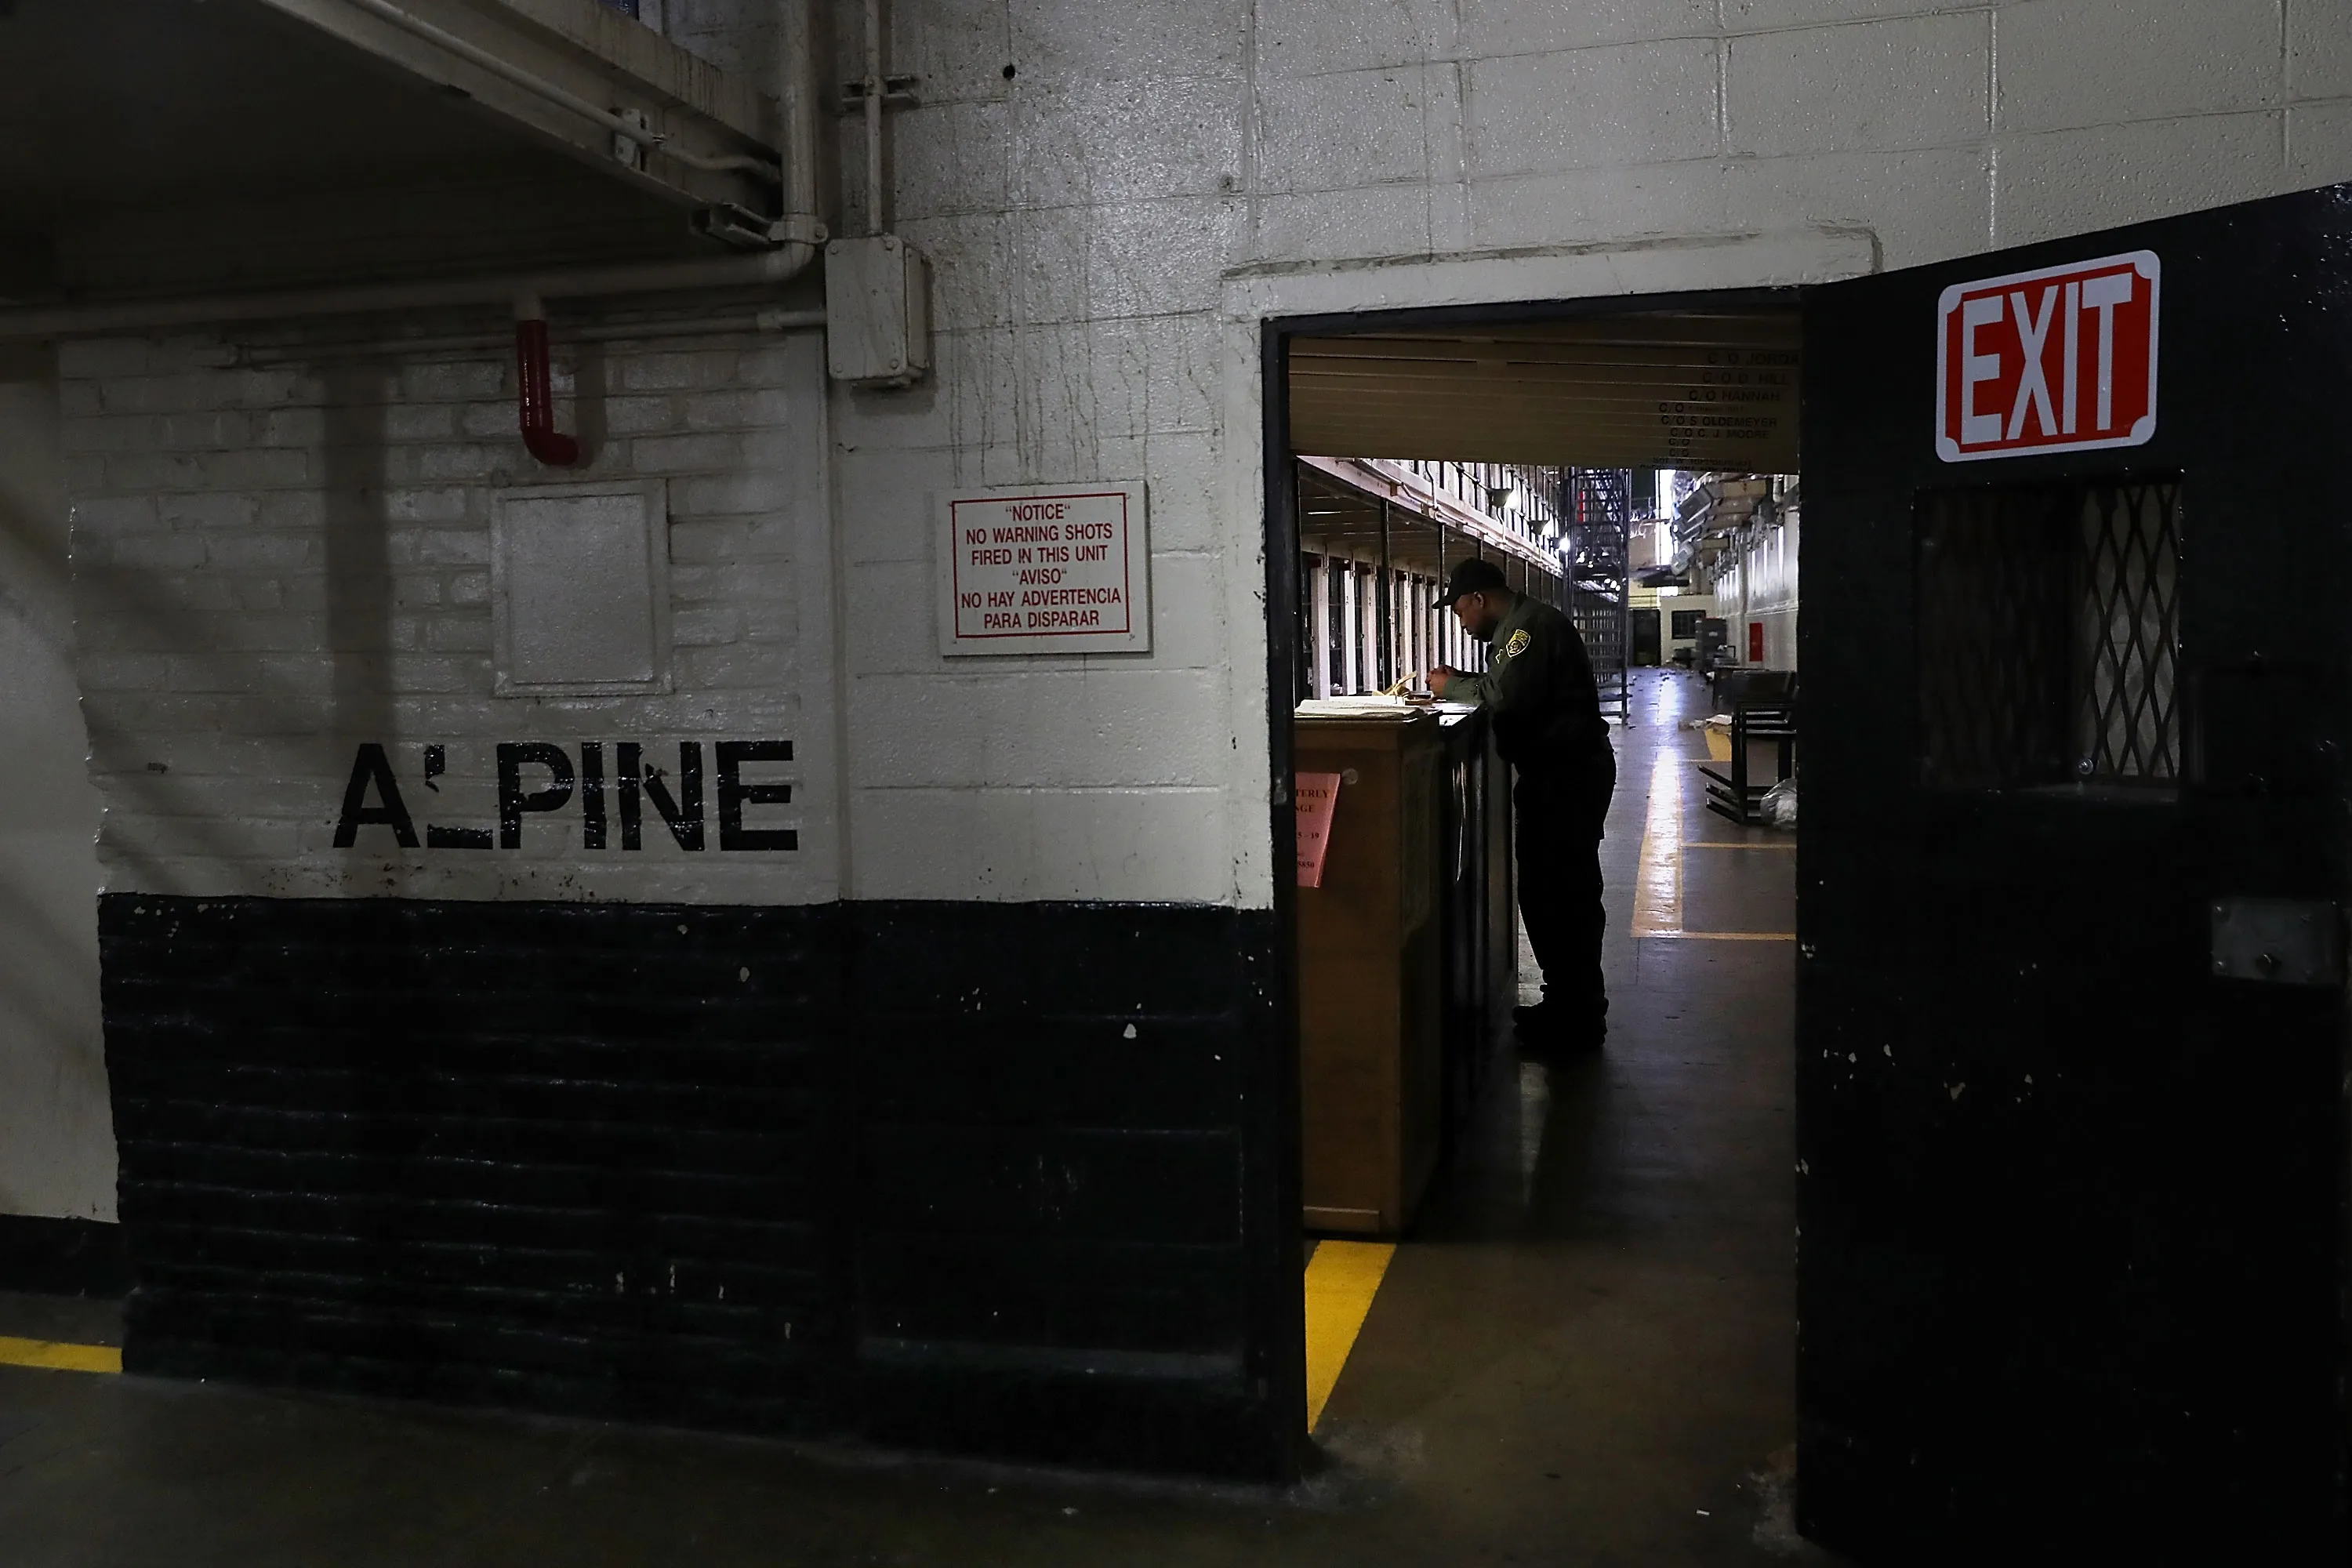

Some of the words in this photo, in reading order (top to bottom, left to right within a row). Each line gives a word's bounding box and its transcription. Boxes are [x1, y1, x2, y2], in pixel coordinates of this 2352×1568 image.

[1961, 272, 2132, 445] EXIT
[966, 528, 986, 544] NO
[993, 525, 1058, 543] WARNING
[1065, 523, 1112, 540] SHOTS
[971, 549, 1011, 565] FIRED
[1018, 548, 1031, 564] IN
[1038, 546, 1069, 563] THIS
[1076, 545, 1109, 561] UNIT
[961, 593, 982, 608] NO
[988, 591, 1014, 608] HAY
[1022, 588, 1121, 606] ADVERTENCIA
[984, 613, 1022, 628] PARA
[1028, 611, 1099, 627] DISPARAR
[332, 741, 798, 851] ALPINE
